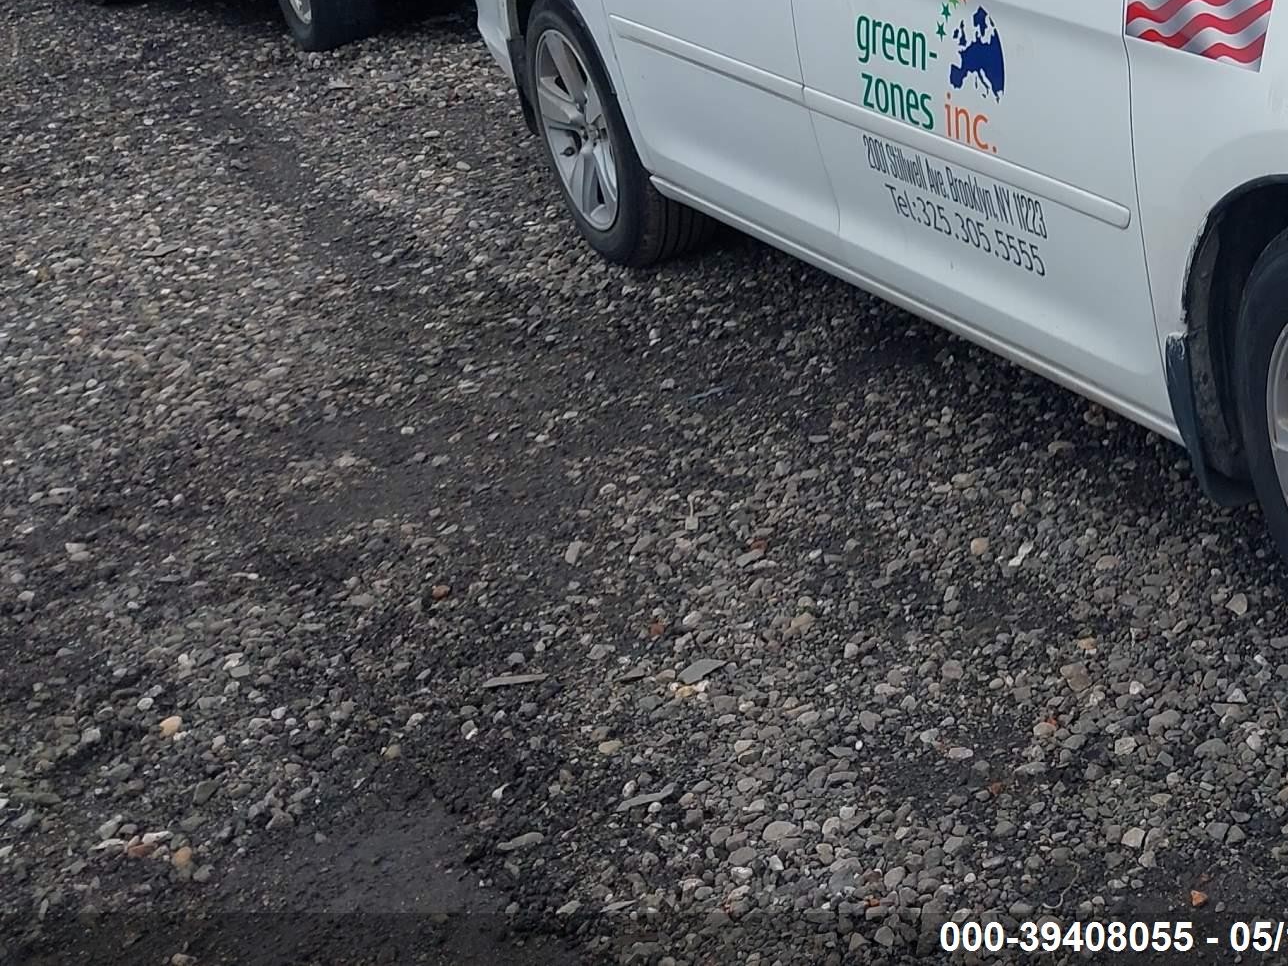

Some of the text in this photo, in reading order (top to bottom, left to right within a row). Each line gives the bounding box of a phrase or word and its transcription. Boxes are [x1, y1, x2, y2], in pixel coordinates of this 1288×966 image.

[856, 15, 938, 71] green-
[861, 72, 997, 154] zones inc.
[862, 134, 890, 176] 2001
[885, 143, 928, 191] Stillwell
[993, 184, 1014, 227] NY
[1012, 191, 1048, 240] 11223
